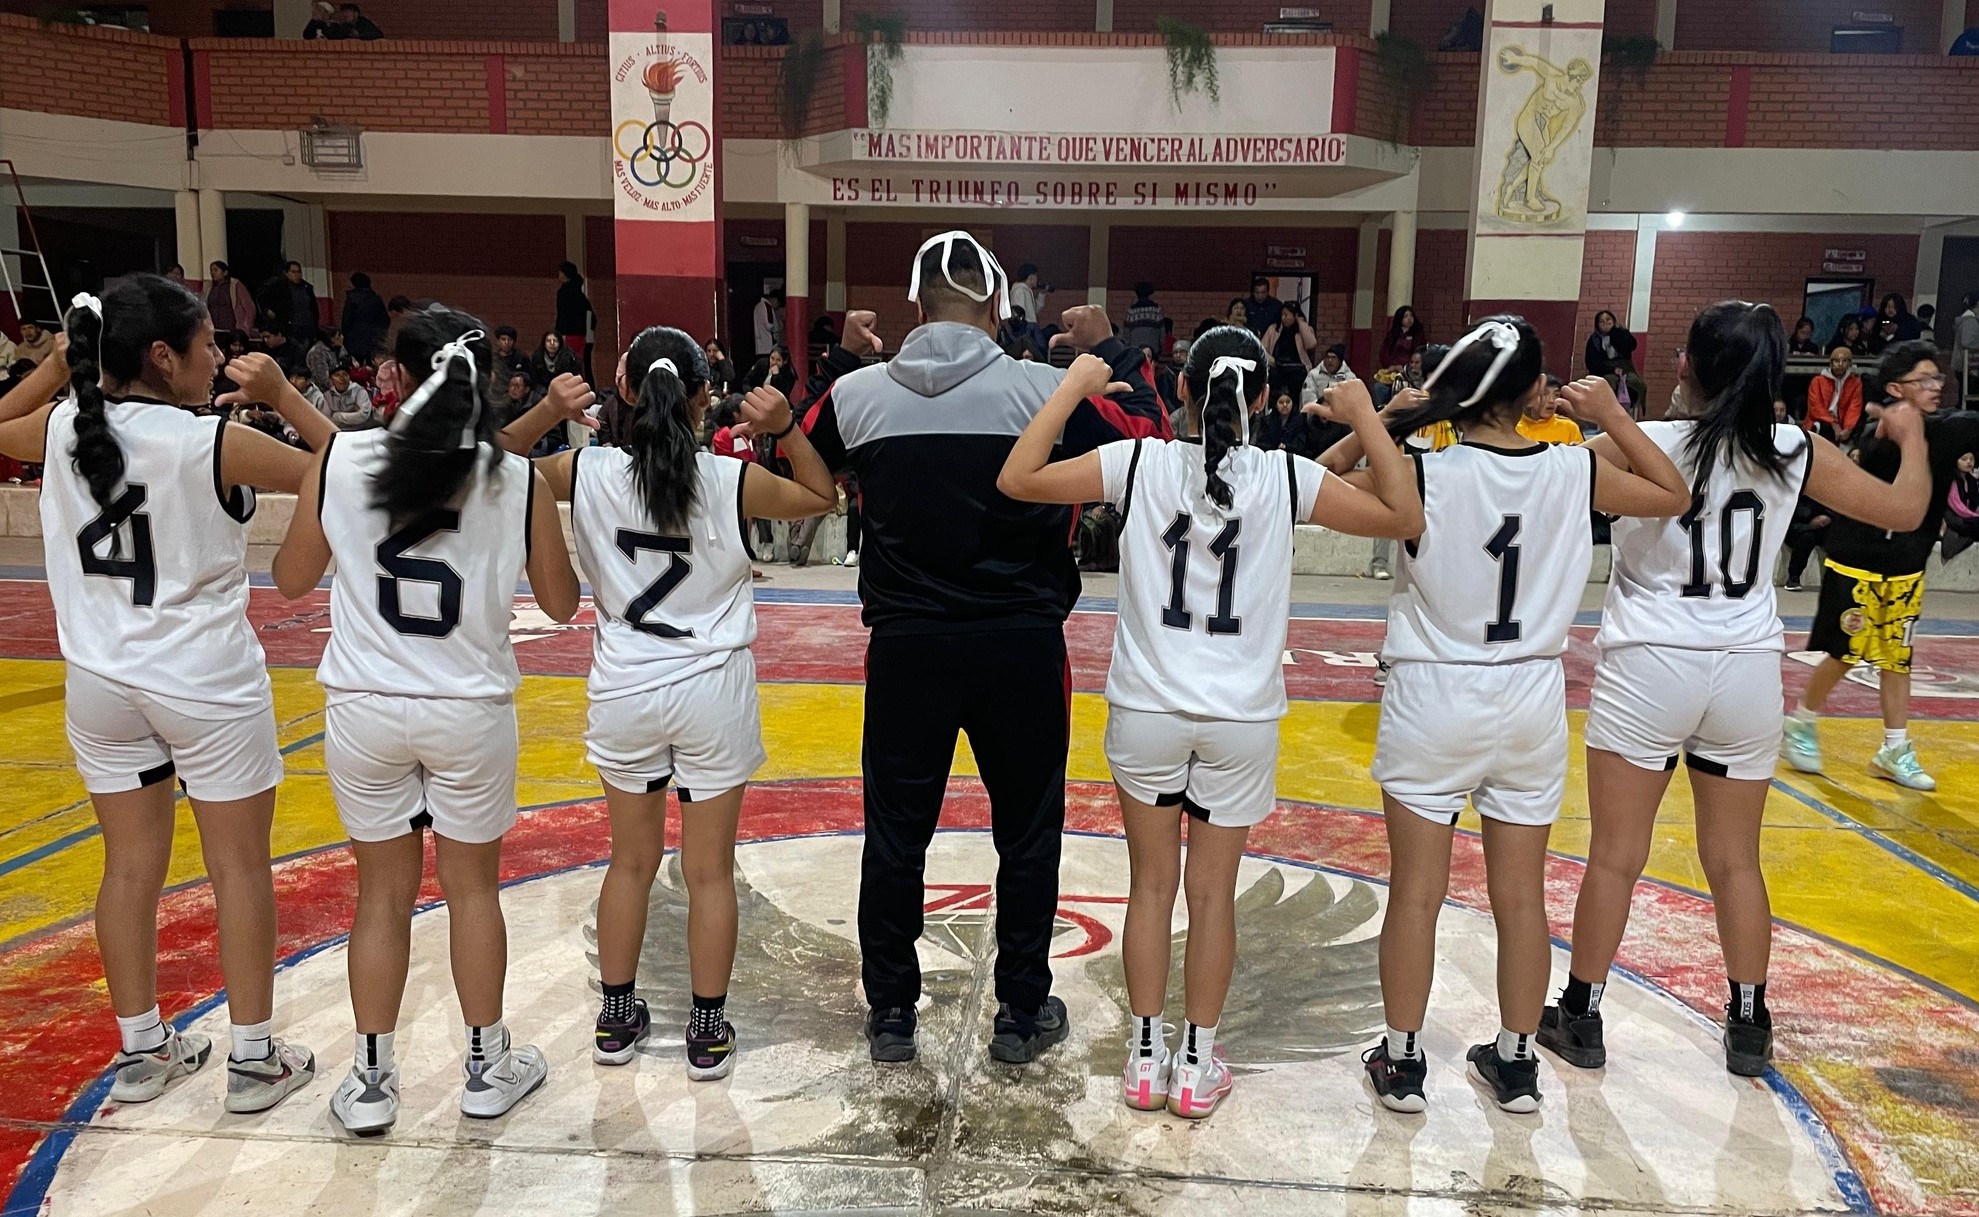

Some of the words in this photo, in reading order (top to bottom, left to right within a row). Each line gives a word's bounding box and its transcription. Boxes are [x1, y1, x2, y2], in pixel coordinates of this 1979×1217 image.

[615, 55, 636, 83] CITIUS
[645, 44, 676, 56] ALTIUS
[681, 52, 708, 84] FORTIUS
[614, 160, 626, 178] MAS
[620, 177, 642, 202] VELOZ
[642, 196, 660, 211] MAS
[661, 200, 681, 212] ALTO
[682, 192, 698, 207] MAS
[695, 162, 713, 196] FUERTE
[832, 177, 860, 201] ES
[870, 178, 898, 202] EL
[911, 179, 1020, 204] TRIUNFO
[1035, 181, 1117, 205] SOBRE
[1133, 182, 1158, 206] SI
[916, 133, 1051, 161] IMPORTANTE
[1057, 136, 1097, 163] QUE
[1101, 137, 1183, 163] VENCER
[1186, 137, 1208, 163] AL
[76, 482, 158, 609] 4
[374, 508, 464, 639] 6
[614, 527, 696, 639] 2
[1160, 510, 1242, 635] 11
[1482, 513, 1522, 644] 1
[1677, 486, 1766, 600] 10
